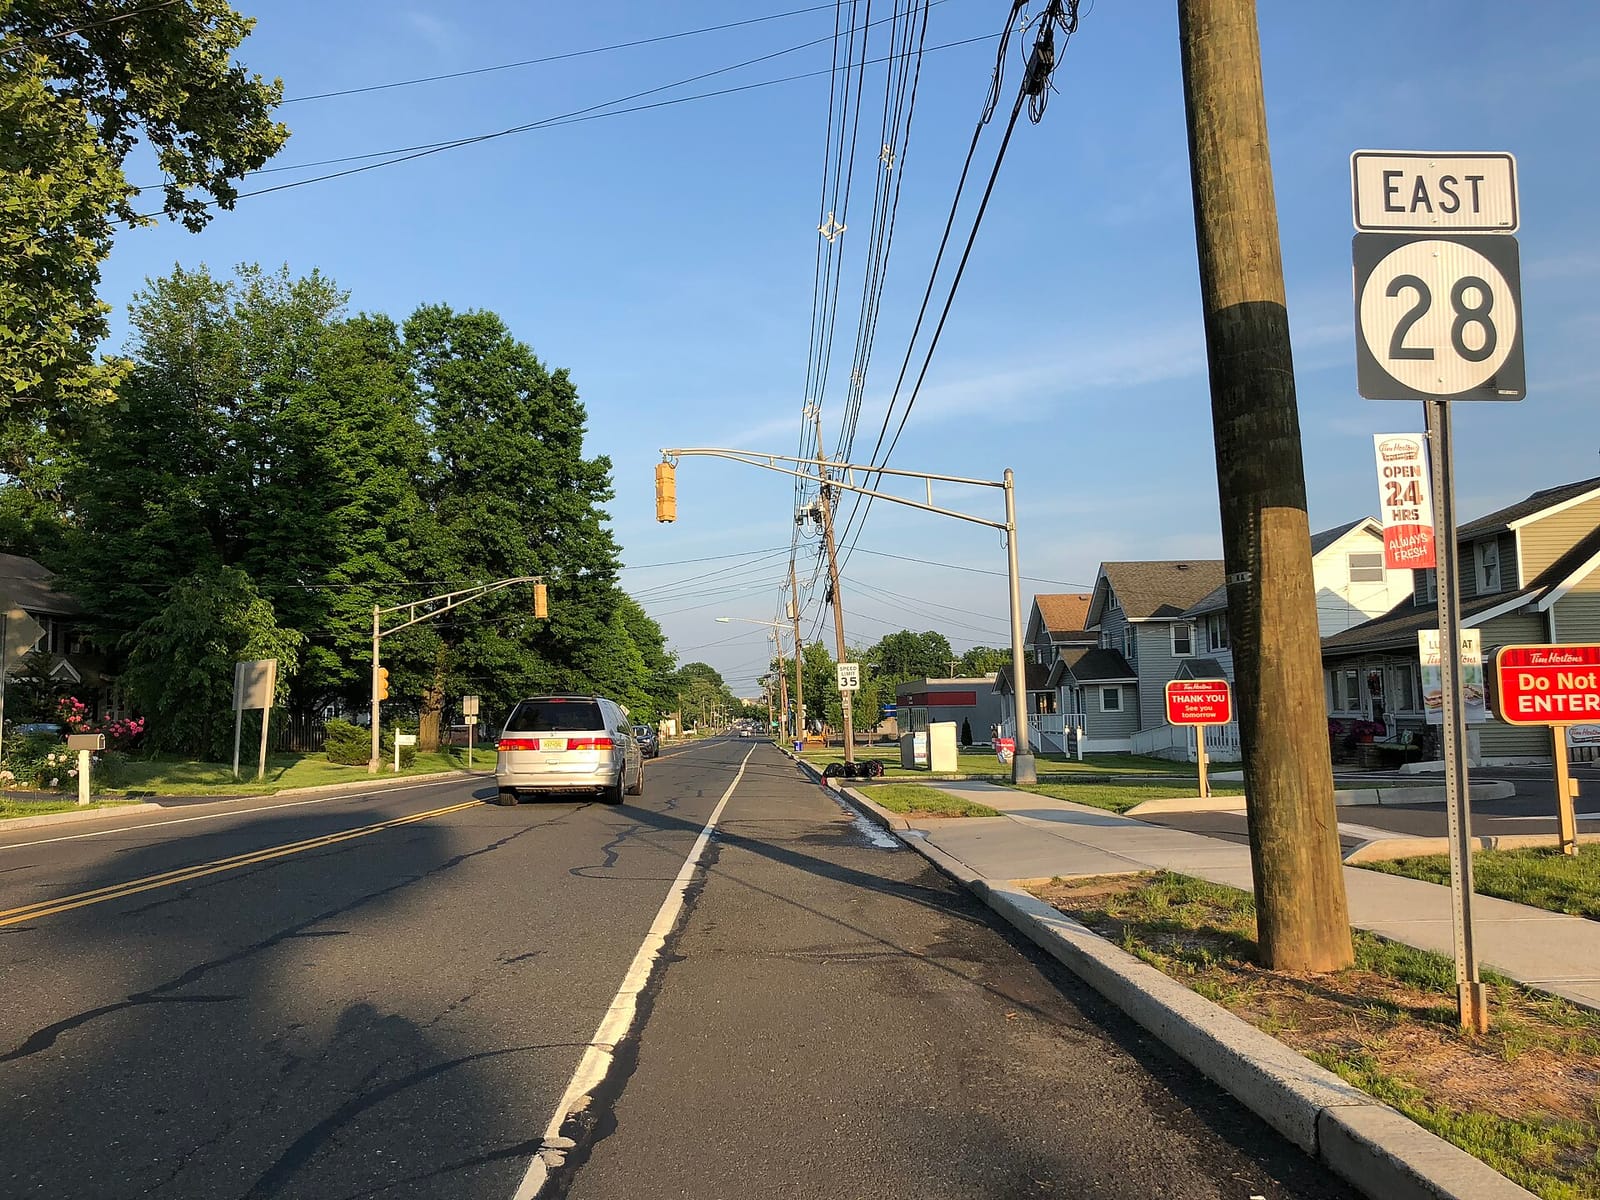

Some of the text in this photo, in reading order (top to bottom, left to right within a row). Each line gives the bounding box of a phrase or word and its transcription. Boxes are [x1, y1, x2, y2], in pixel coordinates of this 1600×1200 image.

[1382, 170, 1484, 213] EAST
[1385, 274, 1497, 362] 28
[1383, 465, 1421, 478] OPEN
[1385, 480, 1423, 506] 24
[1392, 509, 1420, 521] HRS
[1389, 533, 1428, 550] ALWAYS
[1394, 546, 1427, 562] FRESH
[1462, 640, 1472, 649] AT
[1530, 652, 1583, 663] Tim Hortons
[841, 677, 857, 686] 35
[1518, 672, 1597, 690] Do Not
[1172, 694, 1225, 703] THANK YOU
[1518, 694, 1600, 712] ENTER
